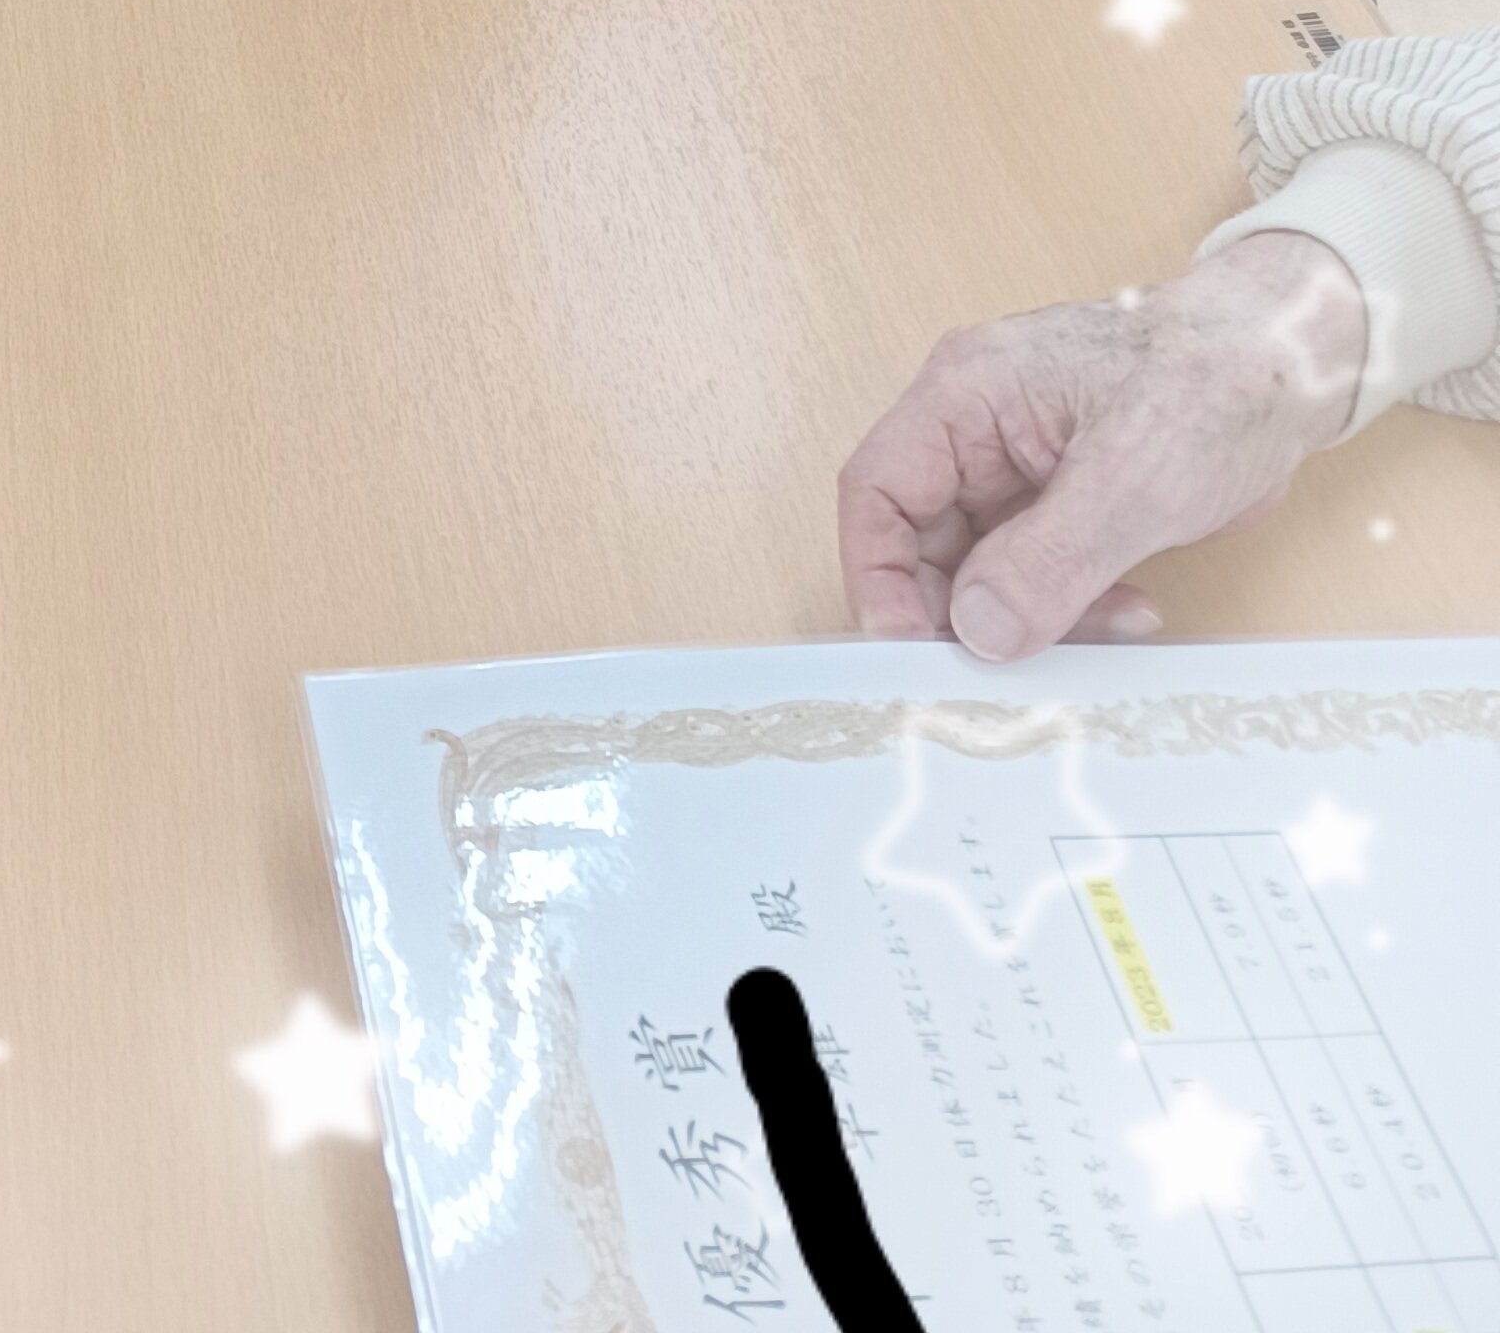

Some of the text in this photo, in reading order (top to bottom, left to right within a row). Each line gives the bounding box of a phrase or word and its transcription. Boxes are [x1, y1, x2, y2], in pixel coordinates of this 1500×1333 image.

[750, 876, 807, 938] 殿
[629, 1013, 788, 1327] 優秀賞
